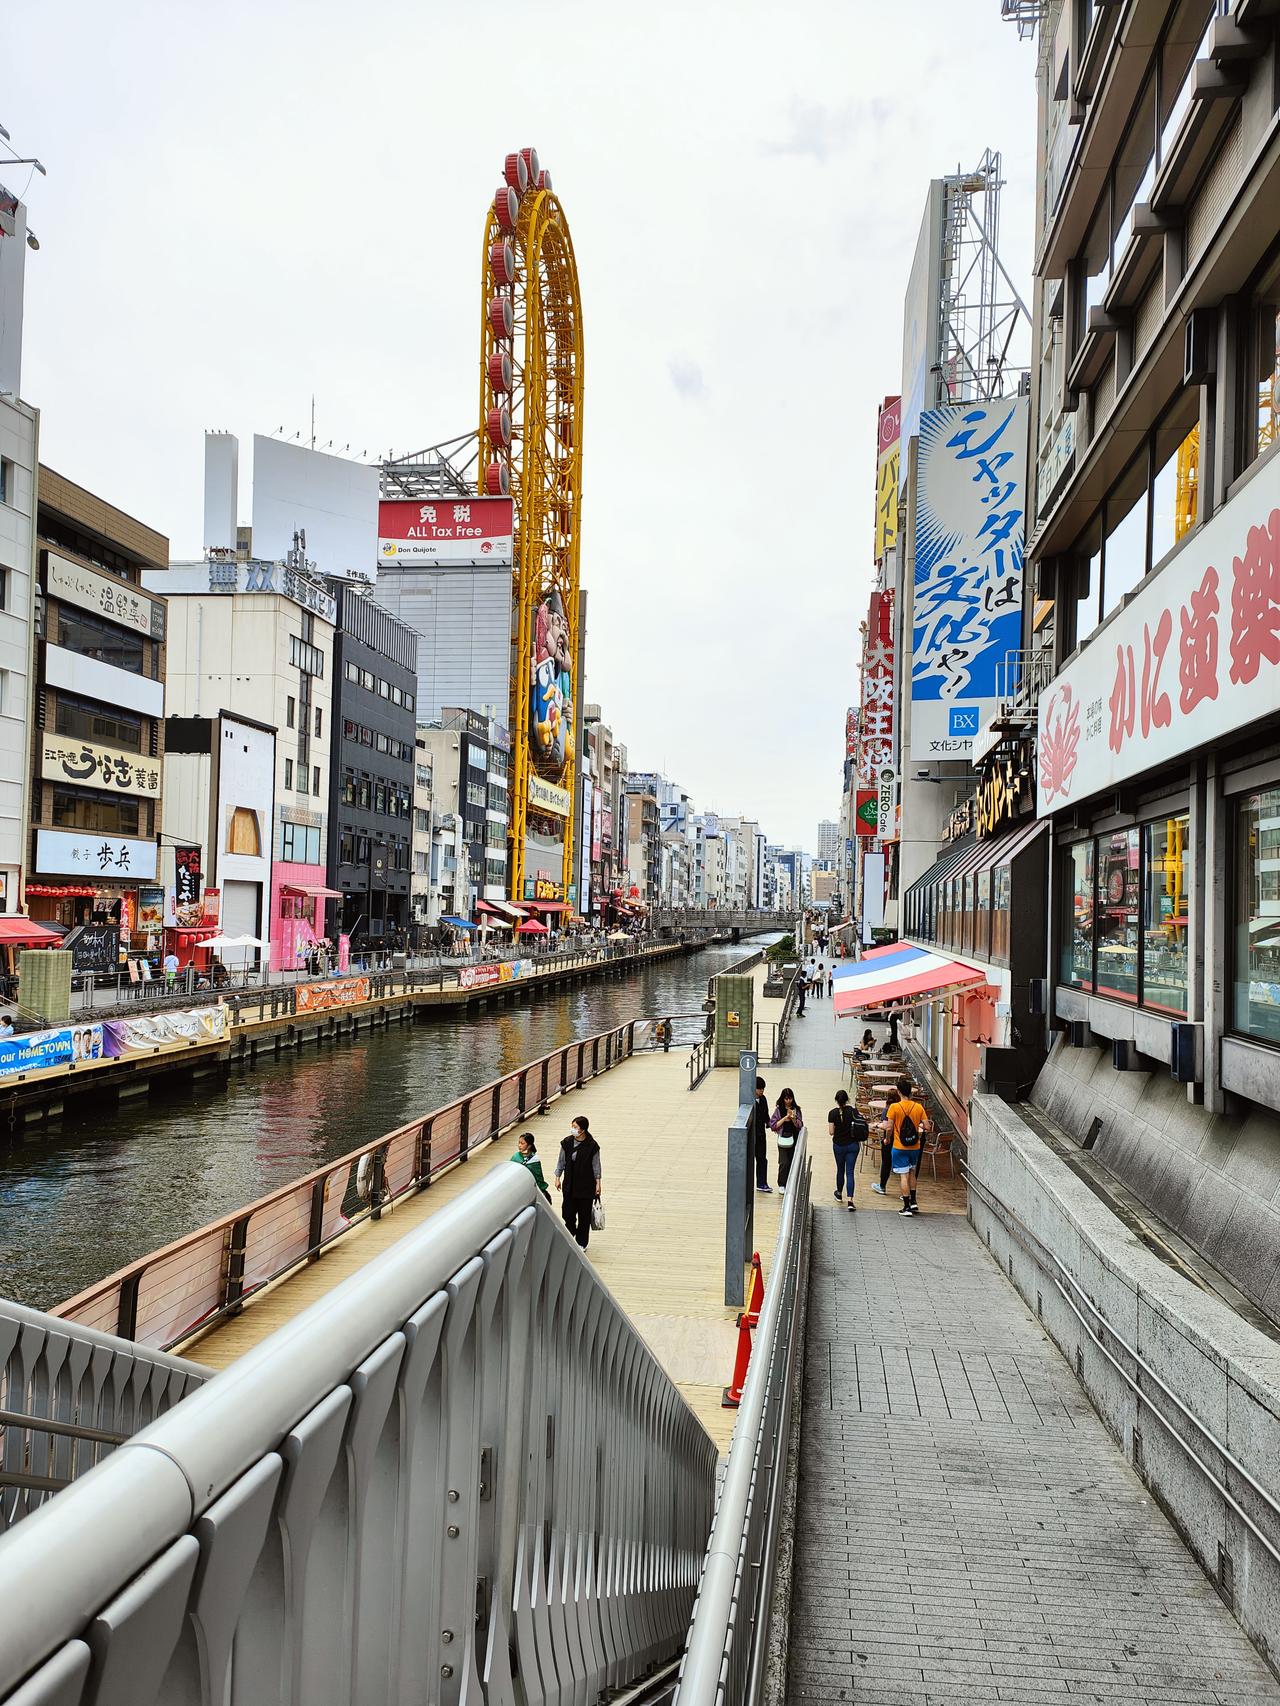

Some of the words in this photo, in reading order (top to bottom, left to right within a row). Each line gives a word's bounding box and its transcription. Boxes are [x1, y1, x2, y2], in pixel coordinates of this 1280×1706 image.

[420, 504, 471, 523] 免税
[407, 526, 428, 537] ALL
[431, 526, 453, 537] Tax
[456, 525, 483, 537] Free
[412, 546, 437, 554] Quijote
[208, 560, 275, 592] 無双
[99, 586, 141, 624] 温野菜
[953, 714, 975, 729] BX
[62, 745, 133, 788] うなぎ
[880, 784, 890, 812] ZERO
[72, 848, 92, 861] 餃子
[97, 842, 131, 872] 歩兵
[18, 1040, 71, 1061] HOMETOWN
